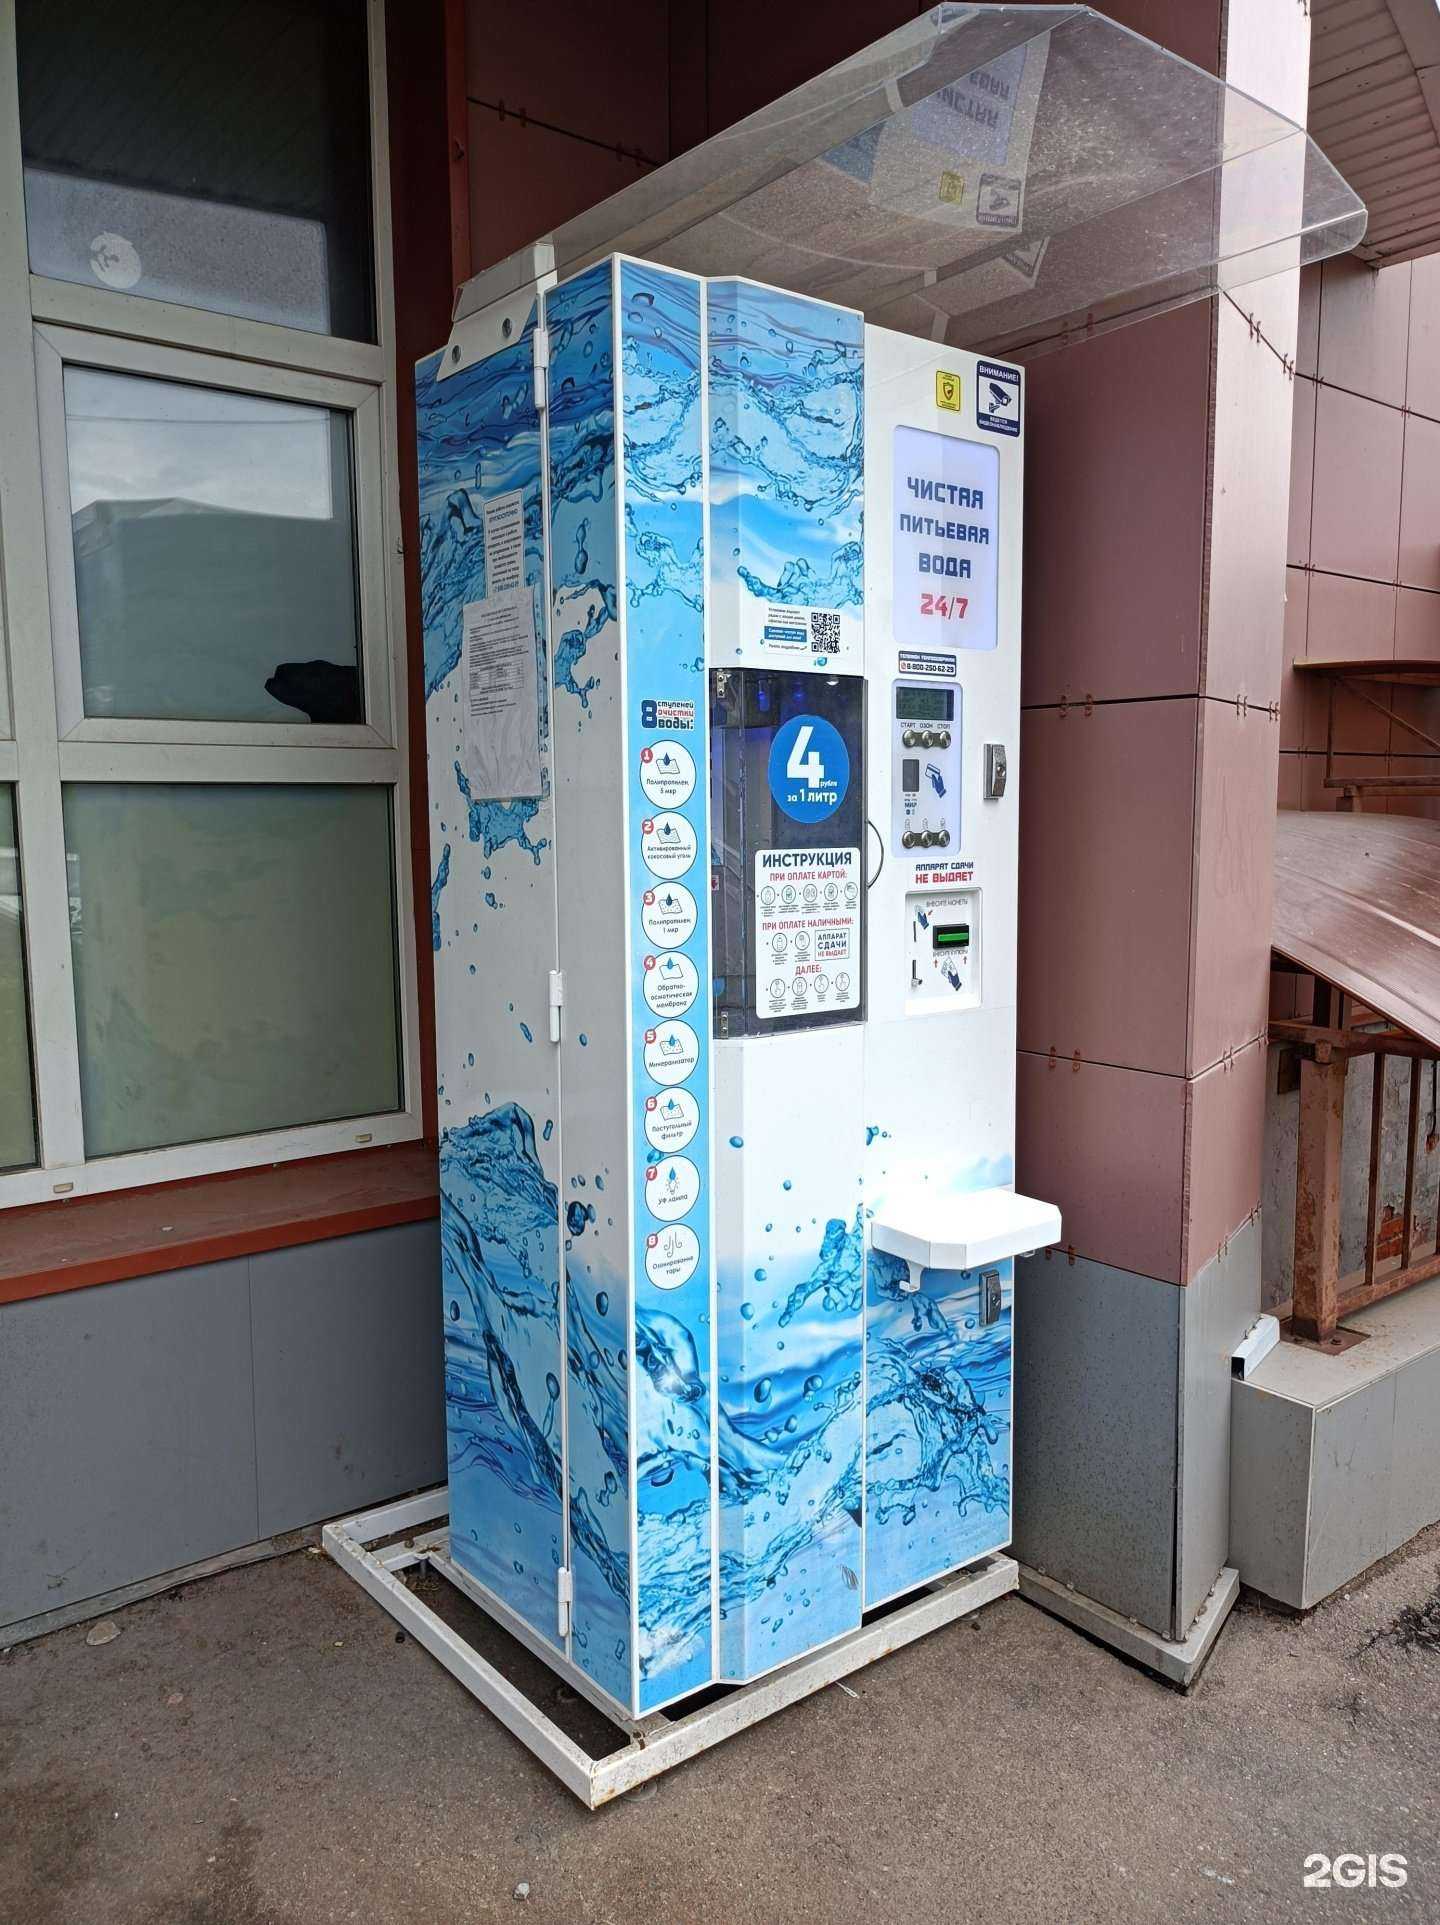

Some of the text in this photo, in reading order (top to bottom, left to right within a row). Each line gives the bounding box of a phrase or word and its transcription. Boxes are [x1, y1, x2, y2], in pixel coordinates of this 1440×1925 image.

[979, 365, 1019, 382] ВНИМАНИЕ!
[907, 476, 984, 510] ЧИСТАЯ
[900, 513, 989, 545] ПИТЬЕВАЯ
[919, 552, 971, 579] ВОДА
[920, 593, 969, 620] 24/7
[642, 700, 657, 728] 8
[657, 709, 694, 717] очистки
[658, 717, 694, 729] воды:
[787, 726, 824, 788] 4
[799, 788, 805, 802] 1
[808, 791, 838, 805] литр
[762, 851, 852, 868] ИНСТРУКЦИЯ
[915, 862, 974, 871] АППАРАТ СДАЧИ
[770, 868, 848, 881] ПРИ ОПЛАТЕ КАРТОЙ:
[915, 871, 974, 884] НЕ ВЫДАЕТ
[762, 916, 854, 931] ПРИ ОПЛАТЕ НАЛИЧНЫМИ:
[818, 932, 847, 941] АППАРАТ
[817, 940, 847, 950] СДАЧИ
[795, 964, 822, 976] ДАЛЕЕ:
